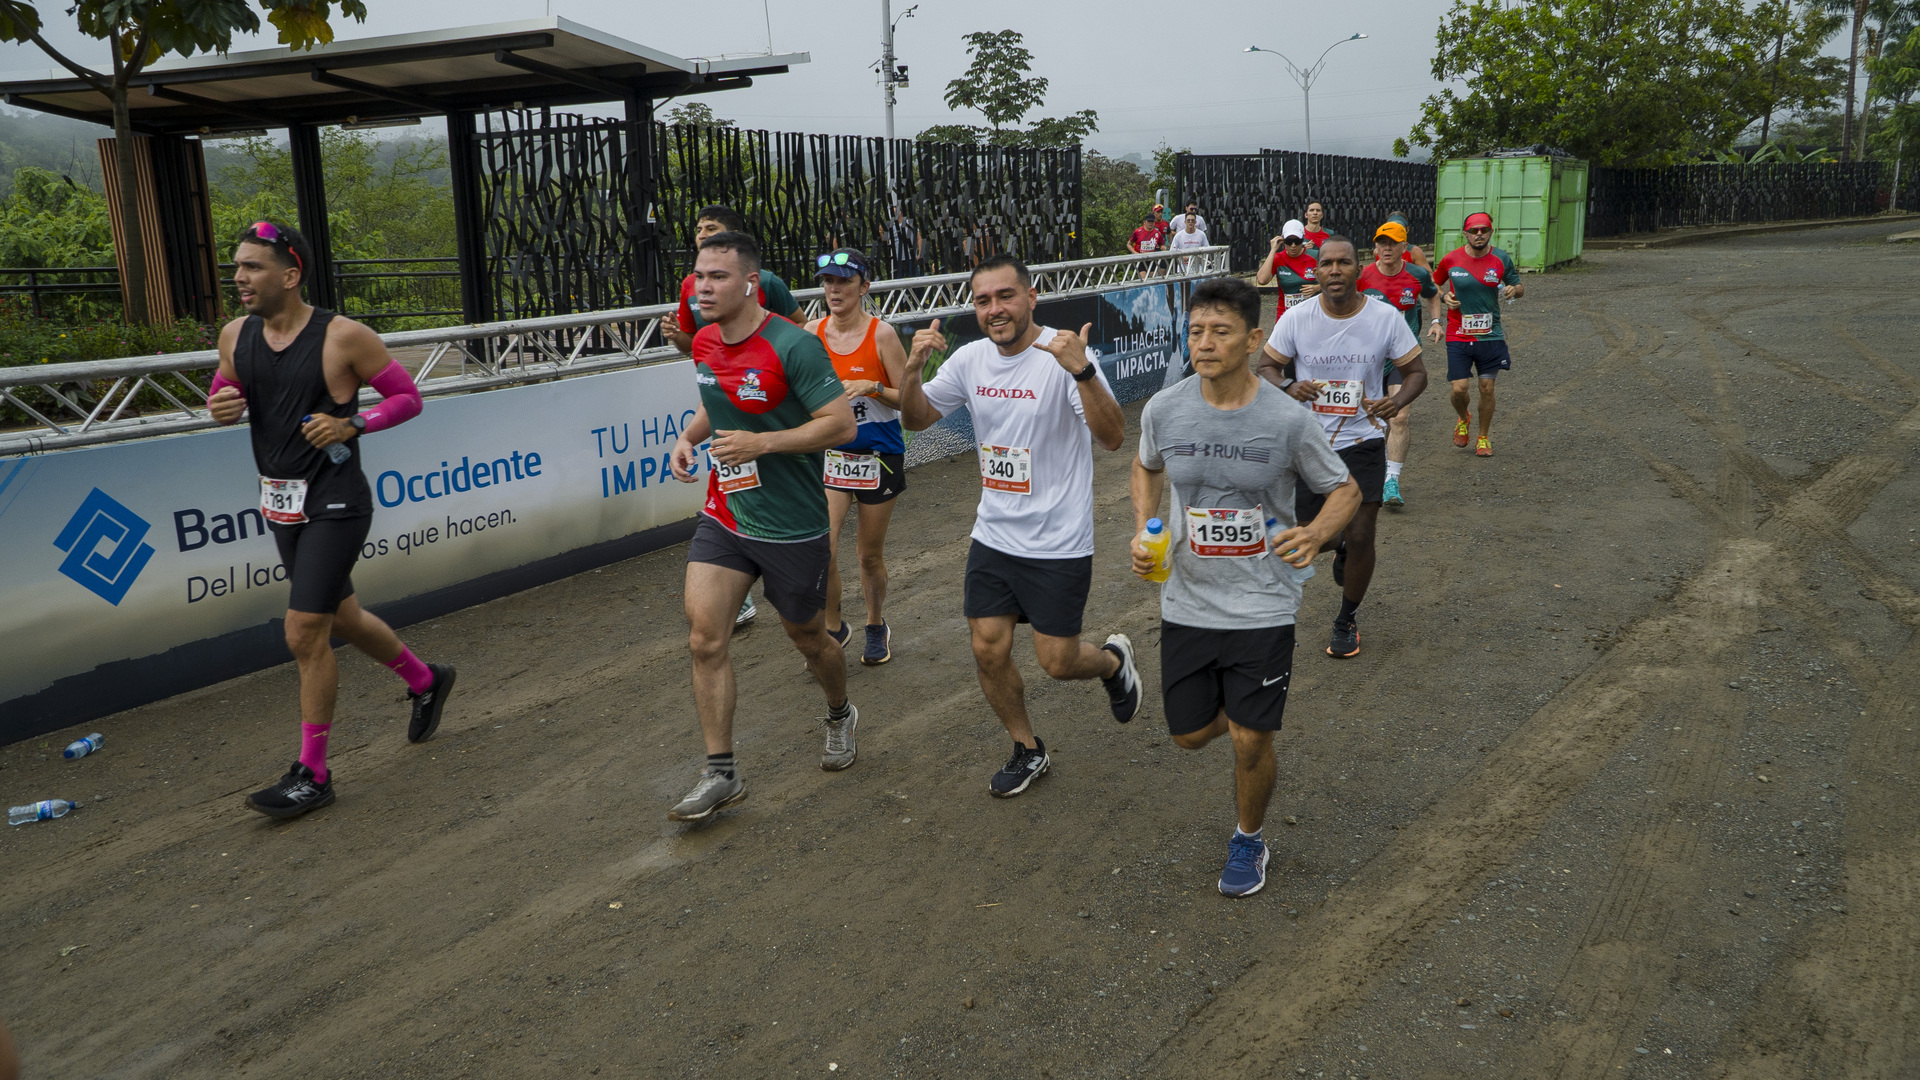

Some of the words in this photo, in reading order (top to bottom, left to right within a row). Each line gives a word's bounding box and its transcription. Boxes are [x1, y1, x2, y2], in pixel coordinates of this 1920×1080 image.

[1468, 320, 1490, 328] 1471
[1113, 335, 1128, 356] TU
[1131, 328, 1168, 352] HACER,
[1116, 350, 1169, 380] IMPACTA.
[1303, 354, 1376, 365] CAMPANELLA
[976, 386, 1037, 400] HONDA
[1325, 391, 1350, 405] 166
[591, 423, 629, 458] TU
[642, 409, 697, 448] HAC
[1213, 444, 1246, 460] RUN
[602, 442, 713, 499] IMPACT
[834, 463, 870, 477] 1047
[989, 459, 1014, 479] 340
[173, 508, 266, 553] Ban
[376, 450, 542, 508] Occidente
[1197, 524, 1253, 543] 1595
[187, 566, 235, 604] Del
[246, 562, 289, 590] lad
[361, 538, 389, 559] os
[397, 526, 439, 556] que
[447, 509, 517, 539] hacen.
